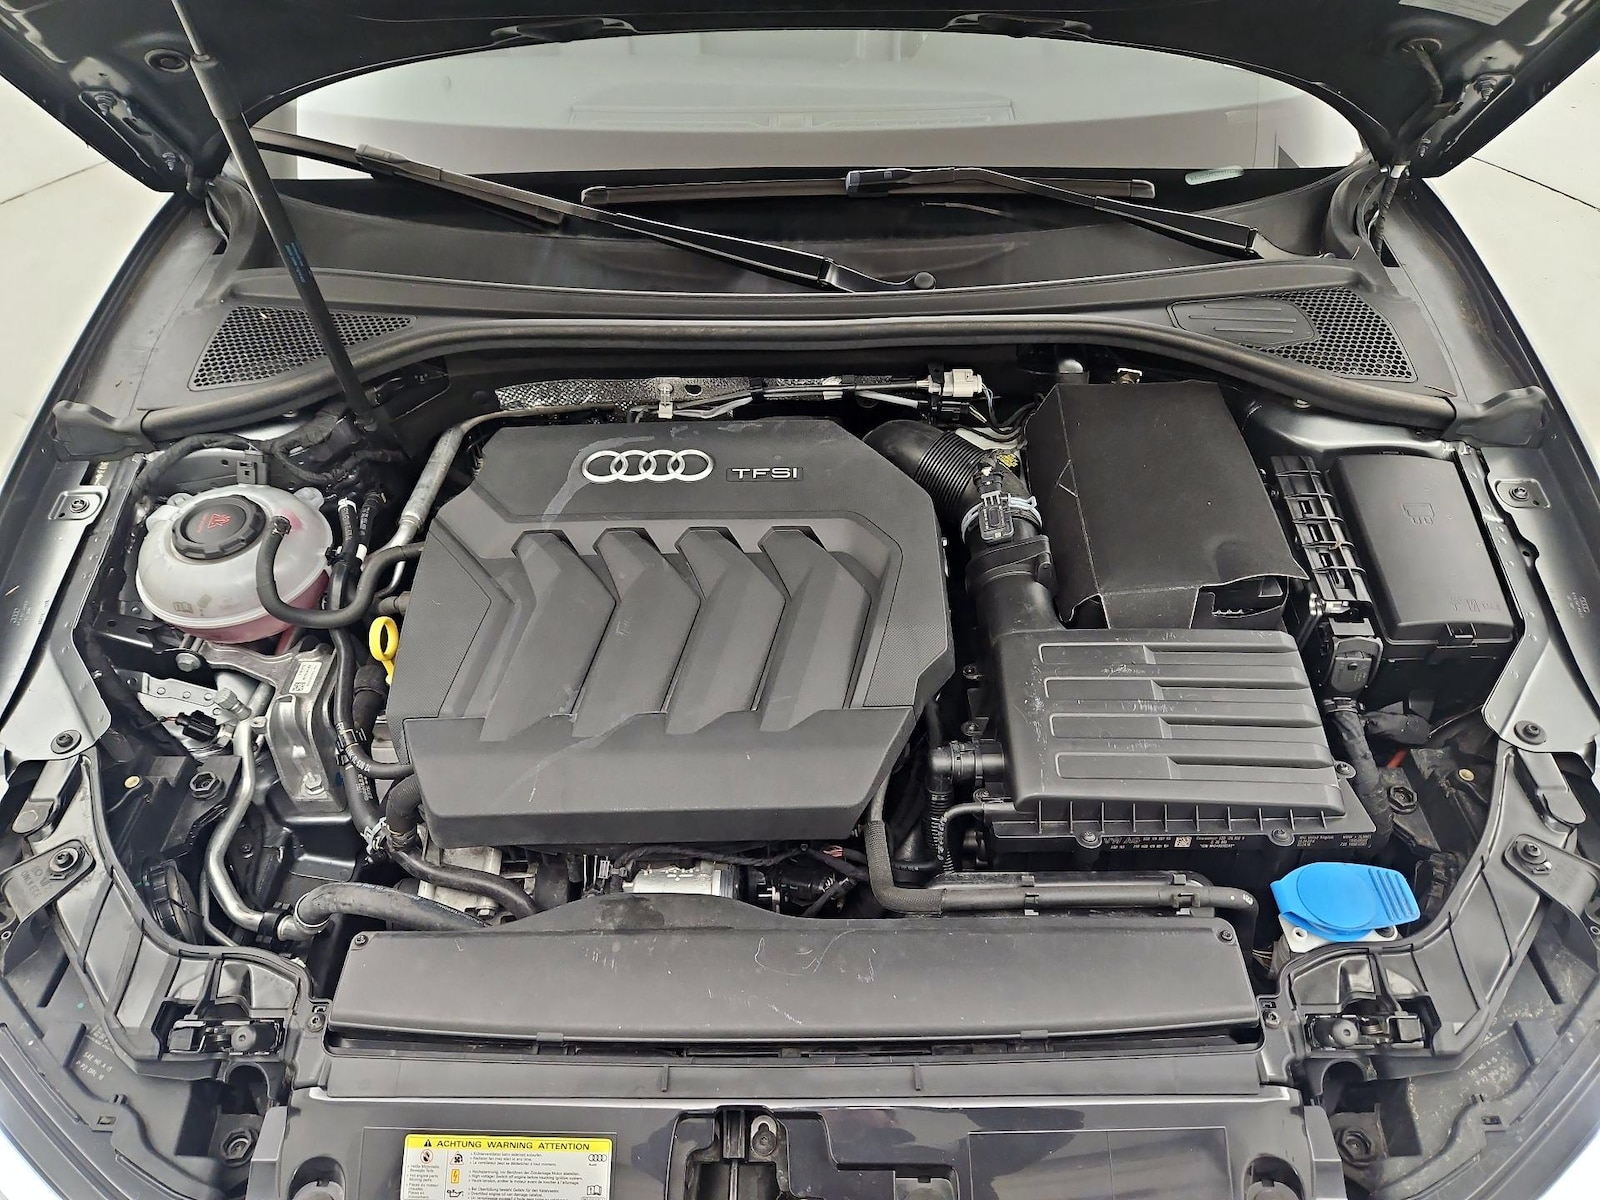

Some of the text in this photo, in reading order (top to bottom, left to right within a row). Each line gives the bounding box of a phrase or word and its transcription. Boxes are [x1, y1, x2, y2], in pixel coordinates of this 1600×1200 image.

[731, 467, 798, 479] TFSI
[437, 1140, 590, 1151] ACHTUNG WARNING ATTENTION
